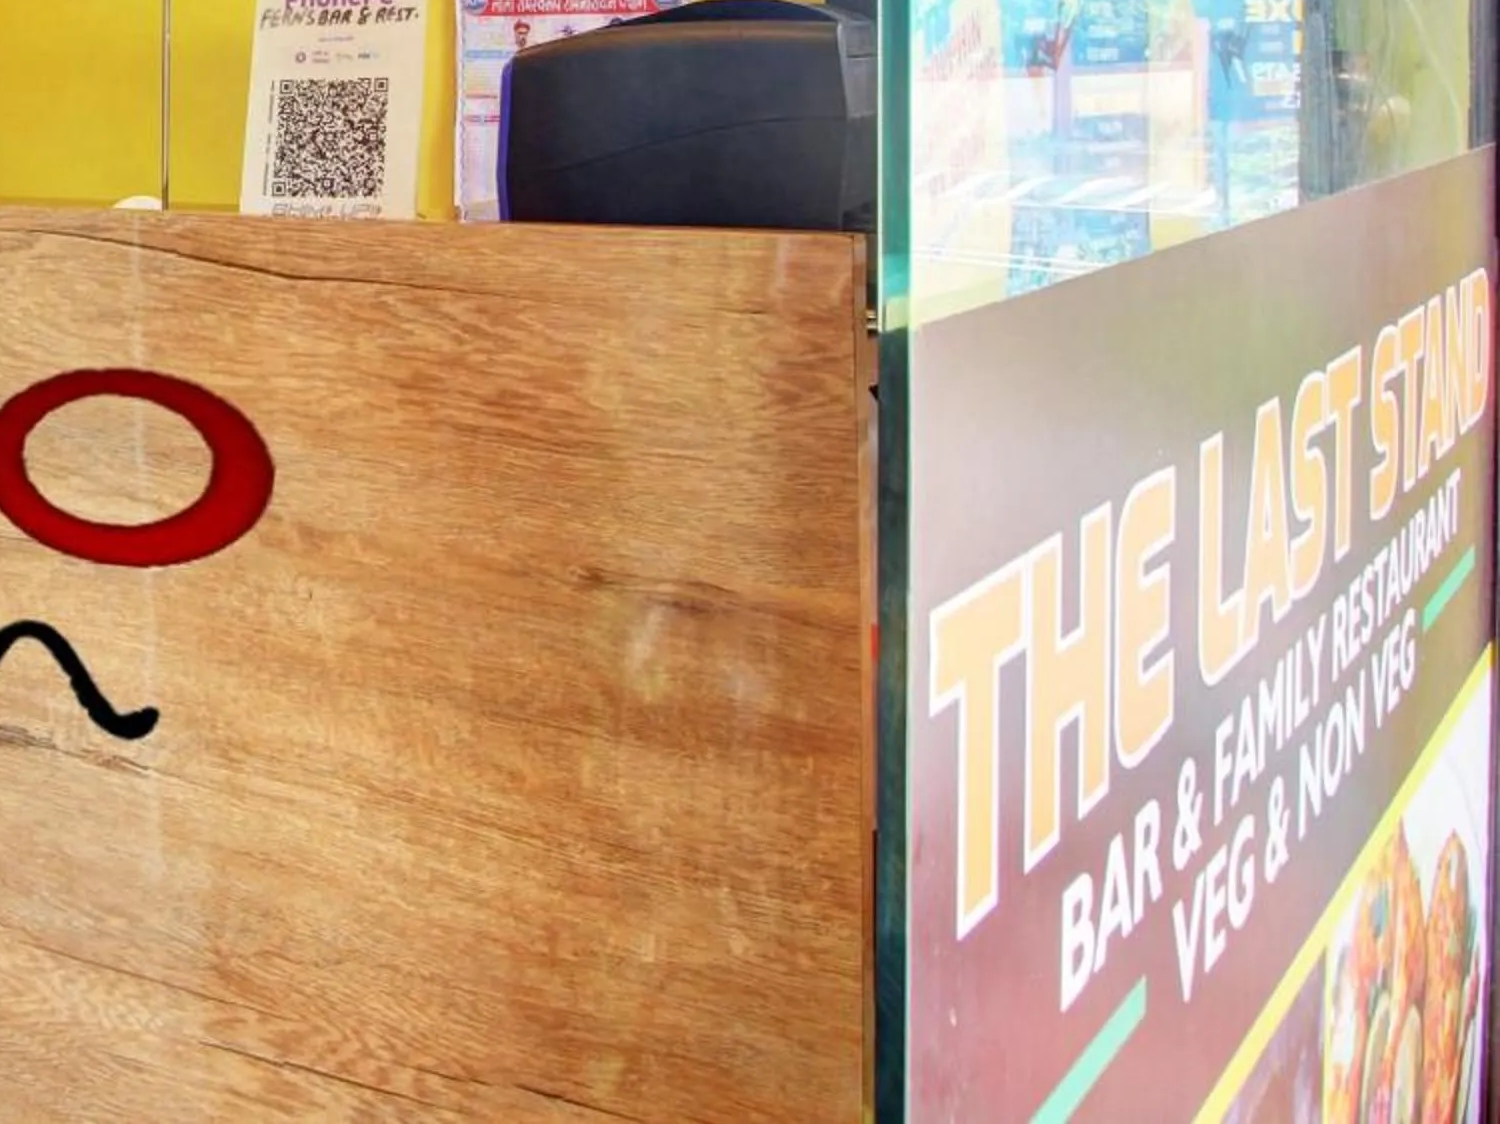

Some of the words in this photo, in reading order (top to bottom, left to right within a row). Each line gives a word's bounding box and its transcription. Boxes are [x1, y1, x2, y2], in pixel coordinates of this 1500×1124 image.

[929, 464, 1177, 943] THE
[1197, 343, 1363, 689] LAST
[1369, 266, 1490, 522] STAND
[1060, 798, 1162, 1014] BAR
[1171, 756, 1205, 874] &
[1212, 623, 1327, 827] FAMILY
[1331, 468, 1462, 678] RESTAURANT
[1171, 847, 1255, 1005] VEG
[1265, 779, 1292, 885] &
[1299, 698, 1366, 839] NON
[1370, 606, 1417, 732] VEG
